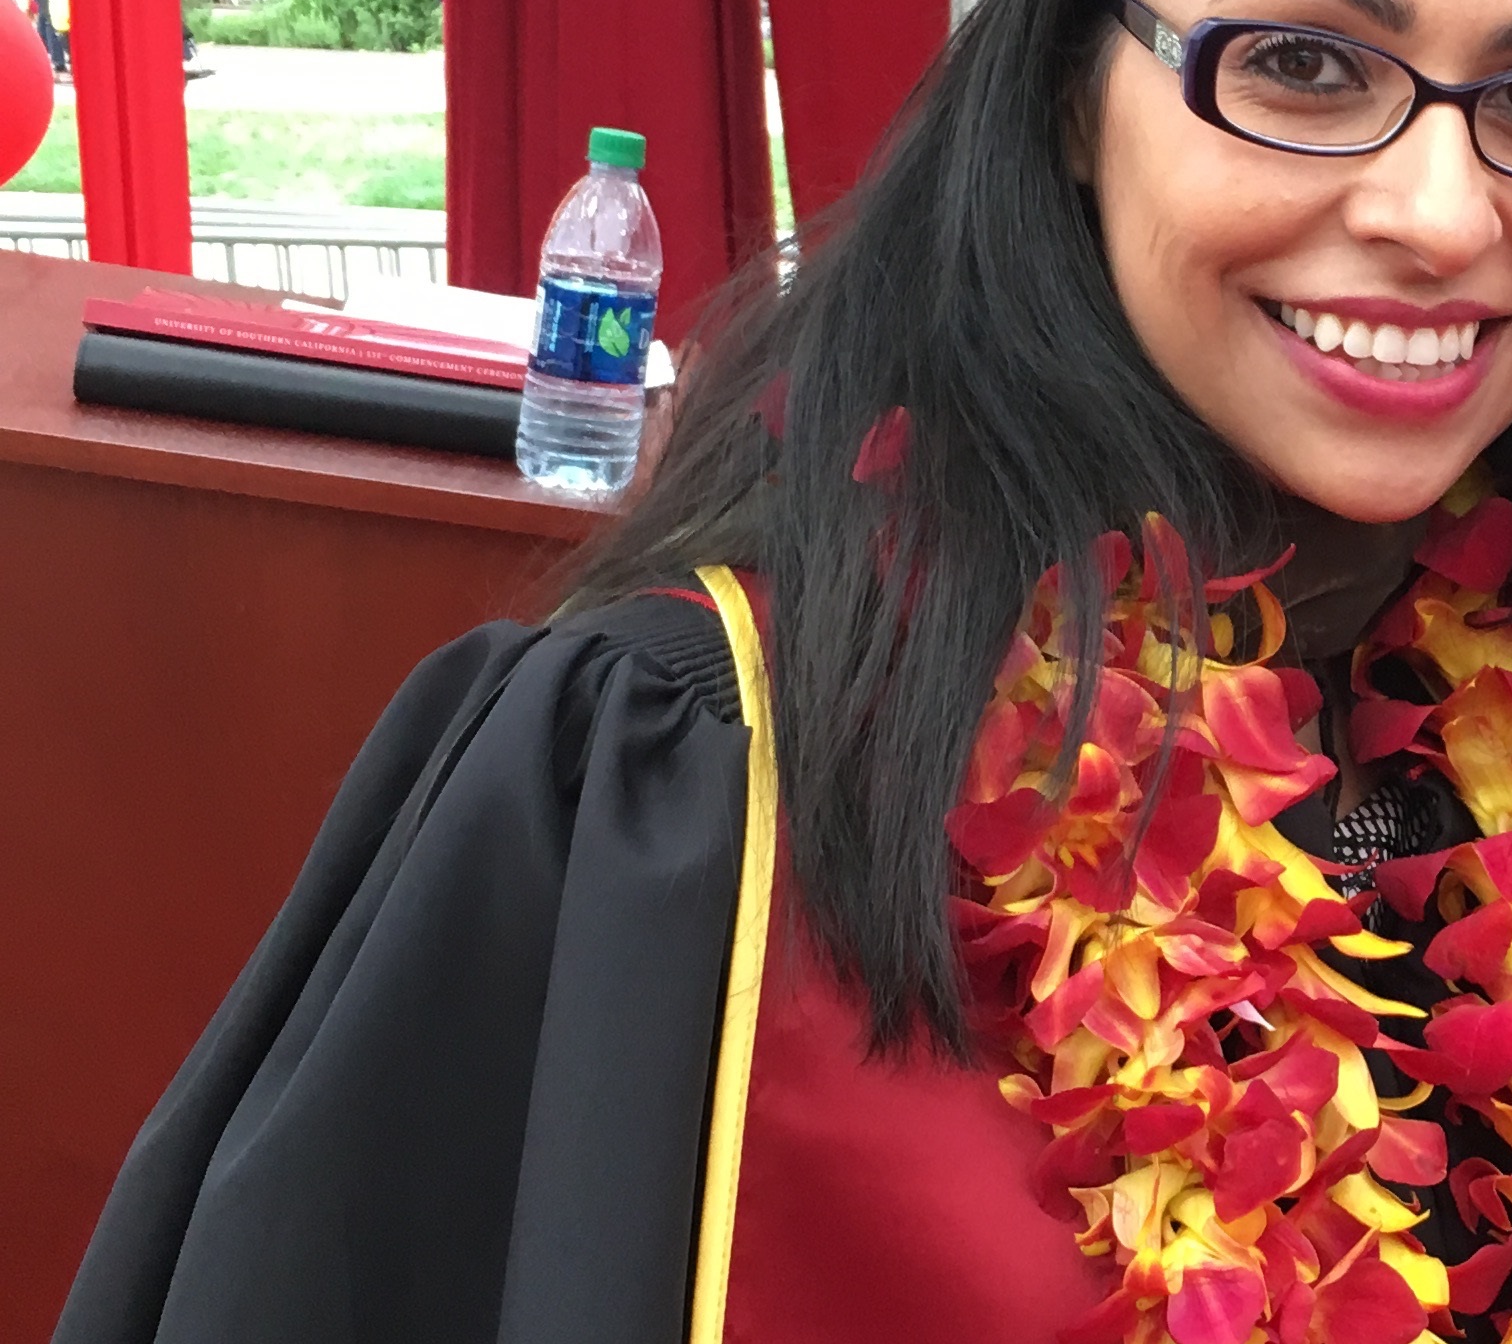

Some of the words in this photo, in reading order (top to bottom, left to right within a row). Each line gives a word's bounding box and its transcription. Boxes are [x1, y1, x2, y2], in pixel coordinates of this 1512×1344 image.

[154, 317, 216, 335] UNIVERSITY
[219, 327, 234, 337] OF
[236, 330, 291, 347] SOUTHERN
[294, 339, 357, 356] CALIFORNIA
[389, 353, 474, 373] COMMENCEMENT
[475, 367, 524, 382] CEREMON
